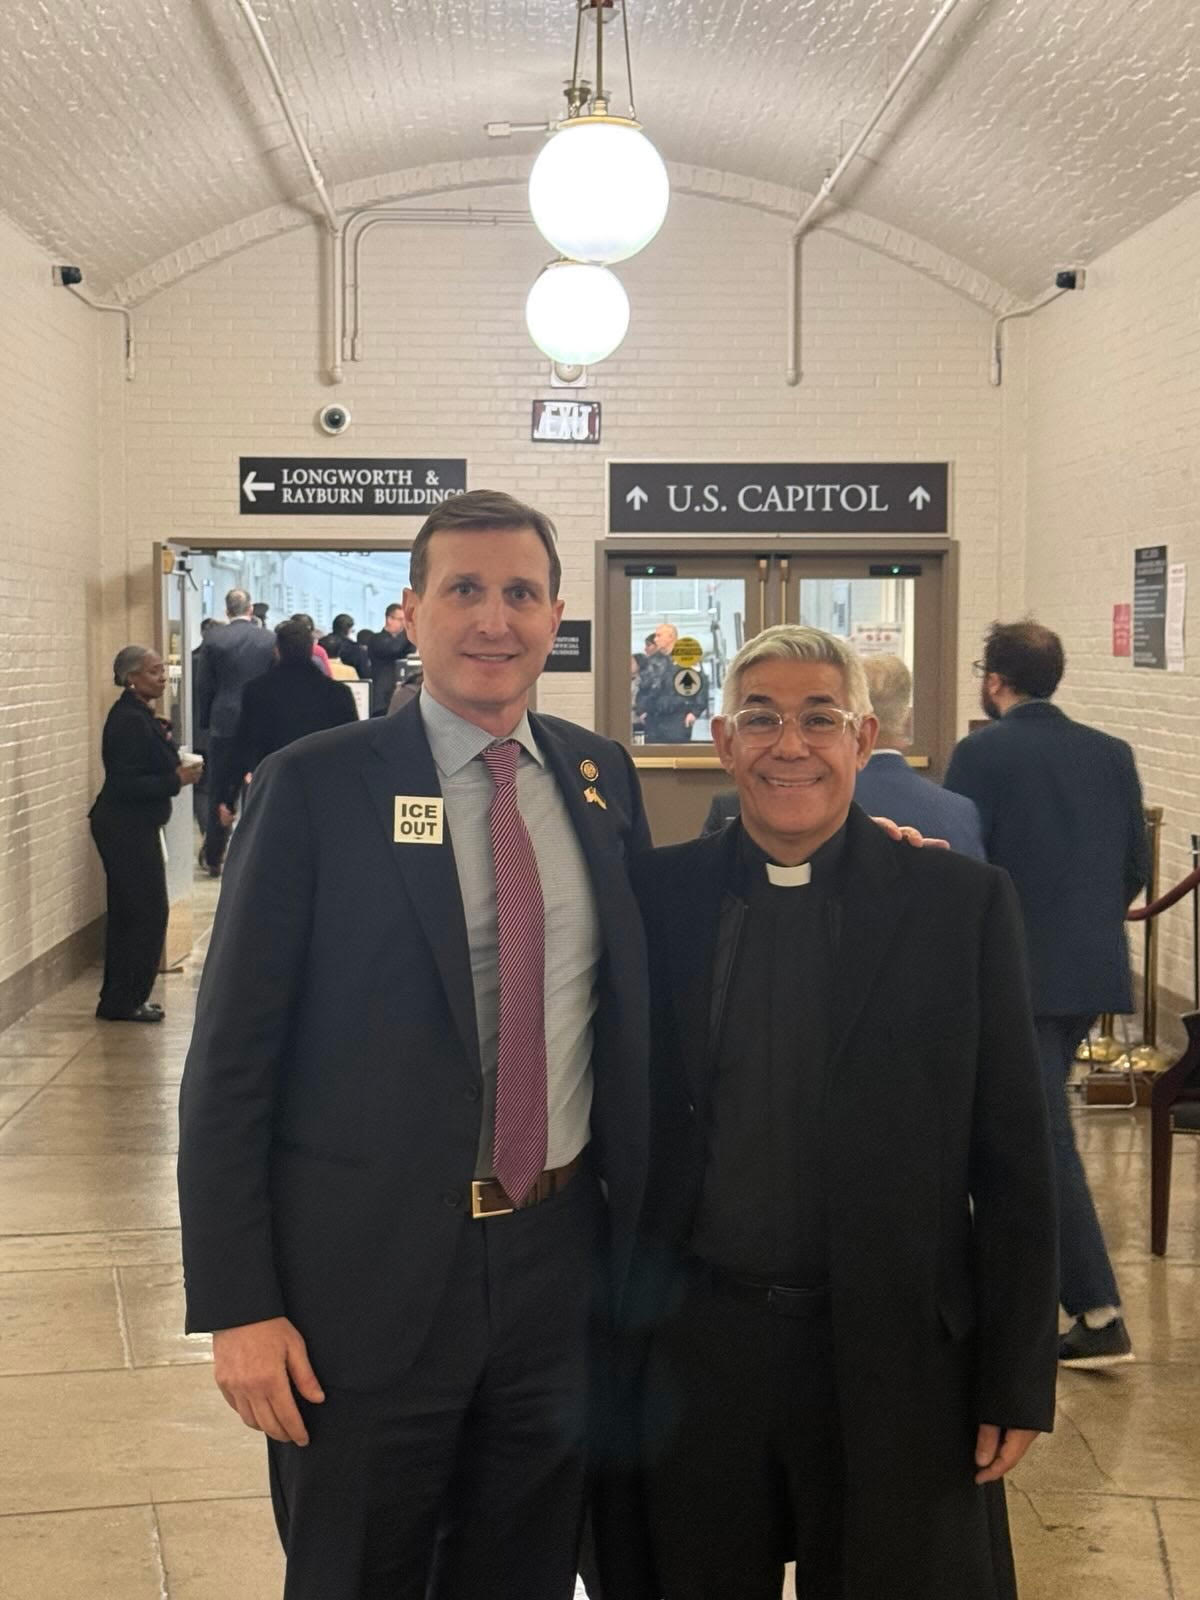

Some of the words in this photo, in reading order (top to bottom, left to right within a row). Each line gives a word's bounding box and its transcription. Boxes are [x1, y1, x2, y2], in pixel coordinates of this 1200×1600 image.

[281, 469, 413, 485] LONGWORTH
[425, 469, 440, 485] &
[282, 488, 364, 504] RAYBURN
[667, 484, 727, 513] U.S.
[737, 484, 889, 513] CAPITOL
[401, 803, 438, 819] ICE
[400, 820, 438, 836] OUT
